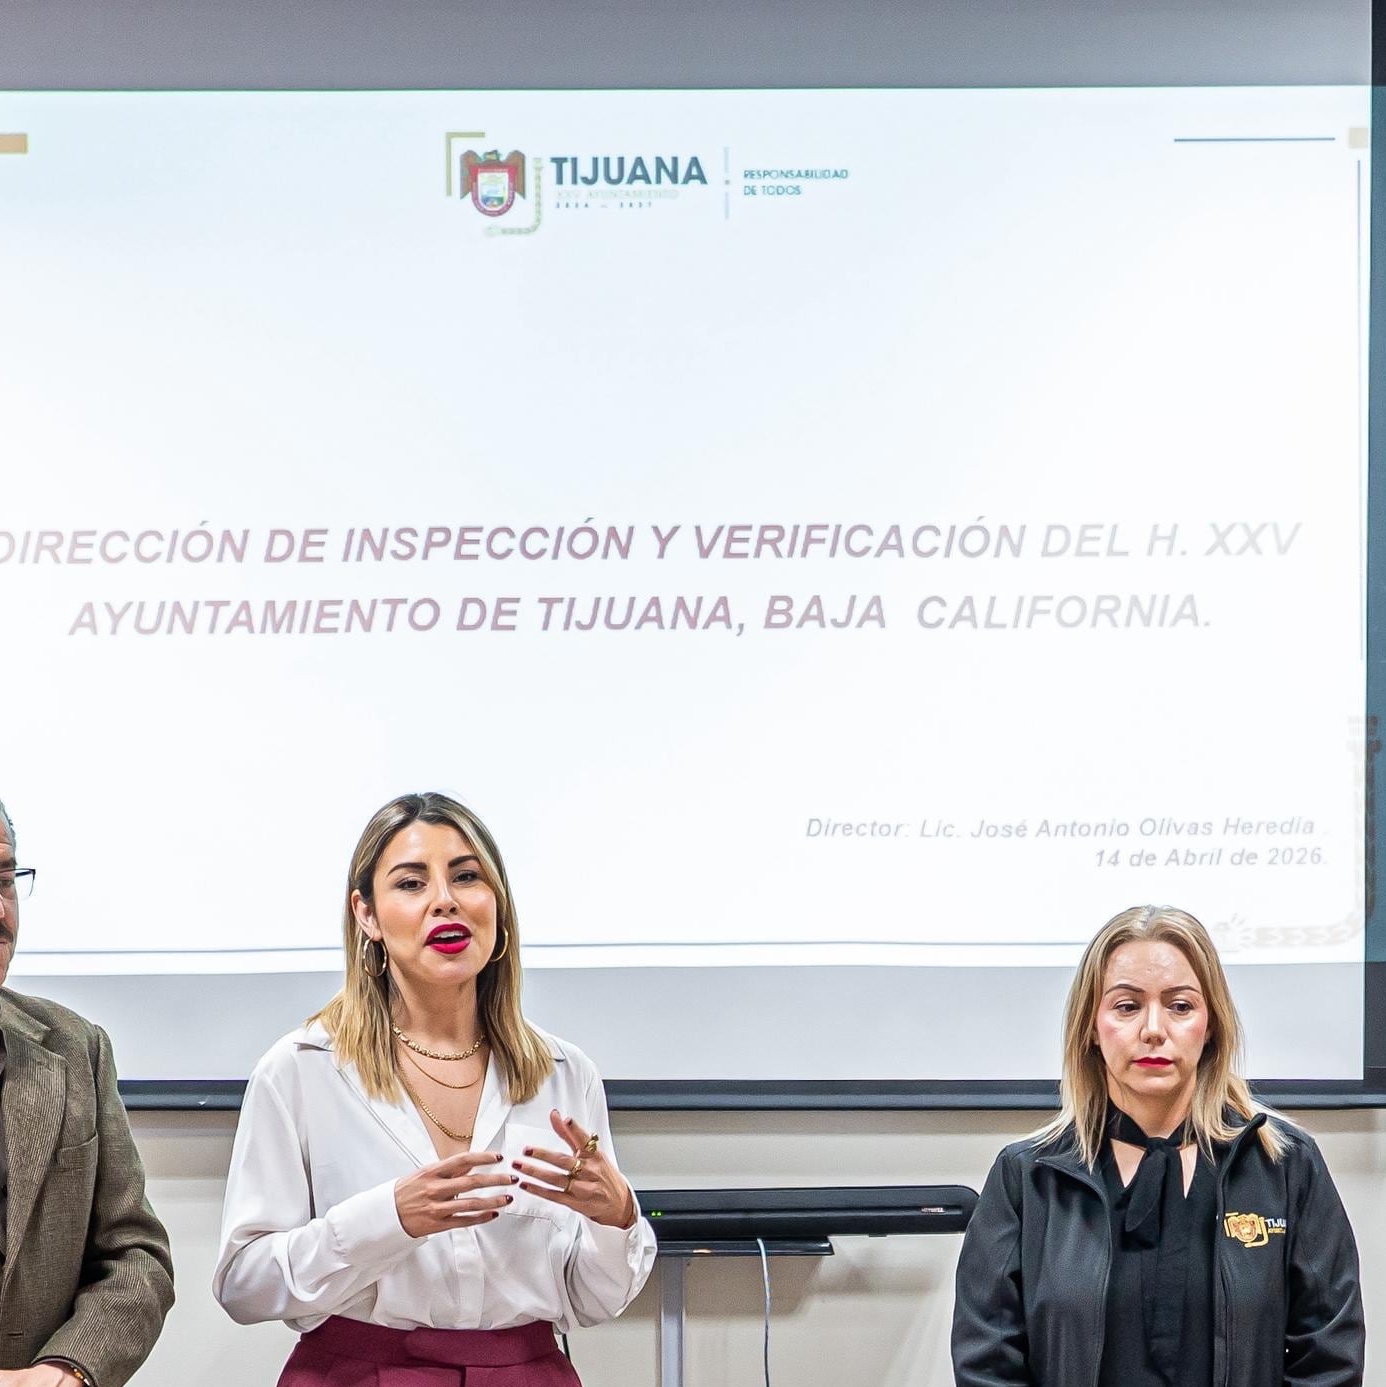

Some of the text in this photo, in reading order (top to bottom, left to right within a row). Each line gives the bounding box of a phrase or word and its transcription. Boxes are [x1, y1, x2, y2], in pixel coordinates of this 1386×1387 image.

[549, 156, 708, 185] TIJUANA
[742, 168, 849, 180] RESPONSABILIDAD
[742, 184, 802, 196] DE TODOS
[263, 528, 330, 563] DE
[341, 516, 636, 563] INSPECCIÓN
[650, 524, 683, 560] Y
[692, 515, 1027, 561] VERIFICACIÓN
[1041, 523, 1130, 559] DEL
[1146, 522, 1189, 557] H.
[1205, 521, 1303, 557] XXV
[68, 593, 1212, 638] AYUNTAMIENTO DE TIJUANA, BAJA CALIFORNIA.
[970, 818, 1028, 839] José
[1035, 817, 1130, 838] Antonio
[1139, 816, 1213, 837] Olivas
[1223, 815, 1315, 836] Heredia
[1095, 848, 1120, 868] 14
[1129, 848, 1157, 867] de
[1164, 847, 1224, 867] Abril
[1230, 847, 1258, 866] de
